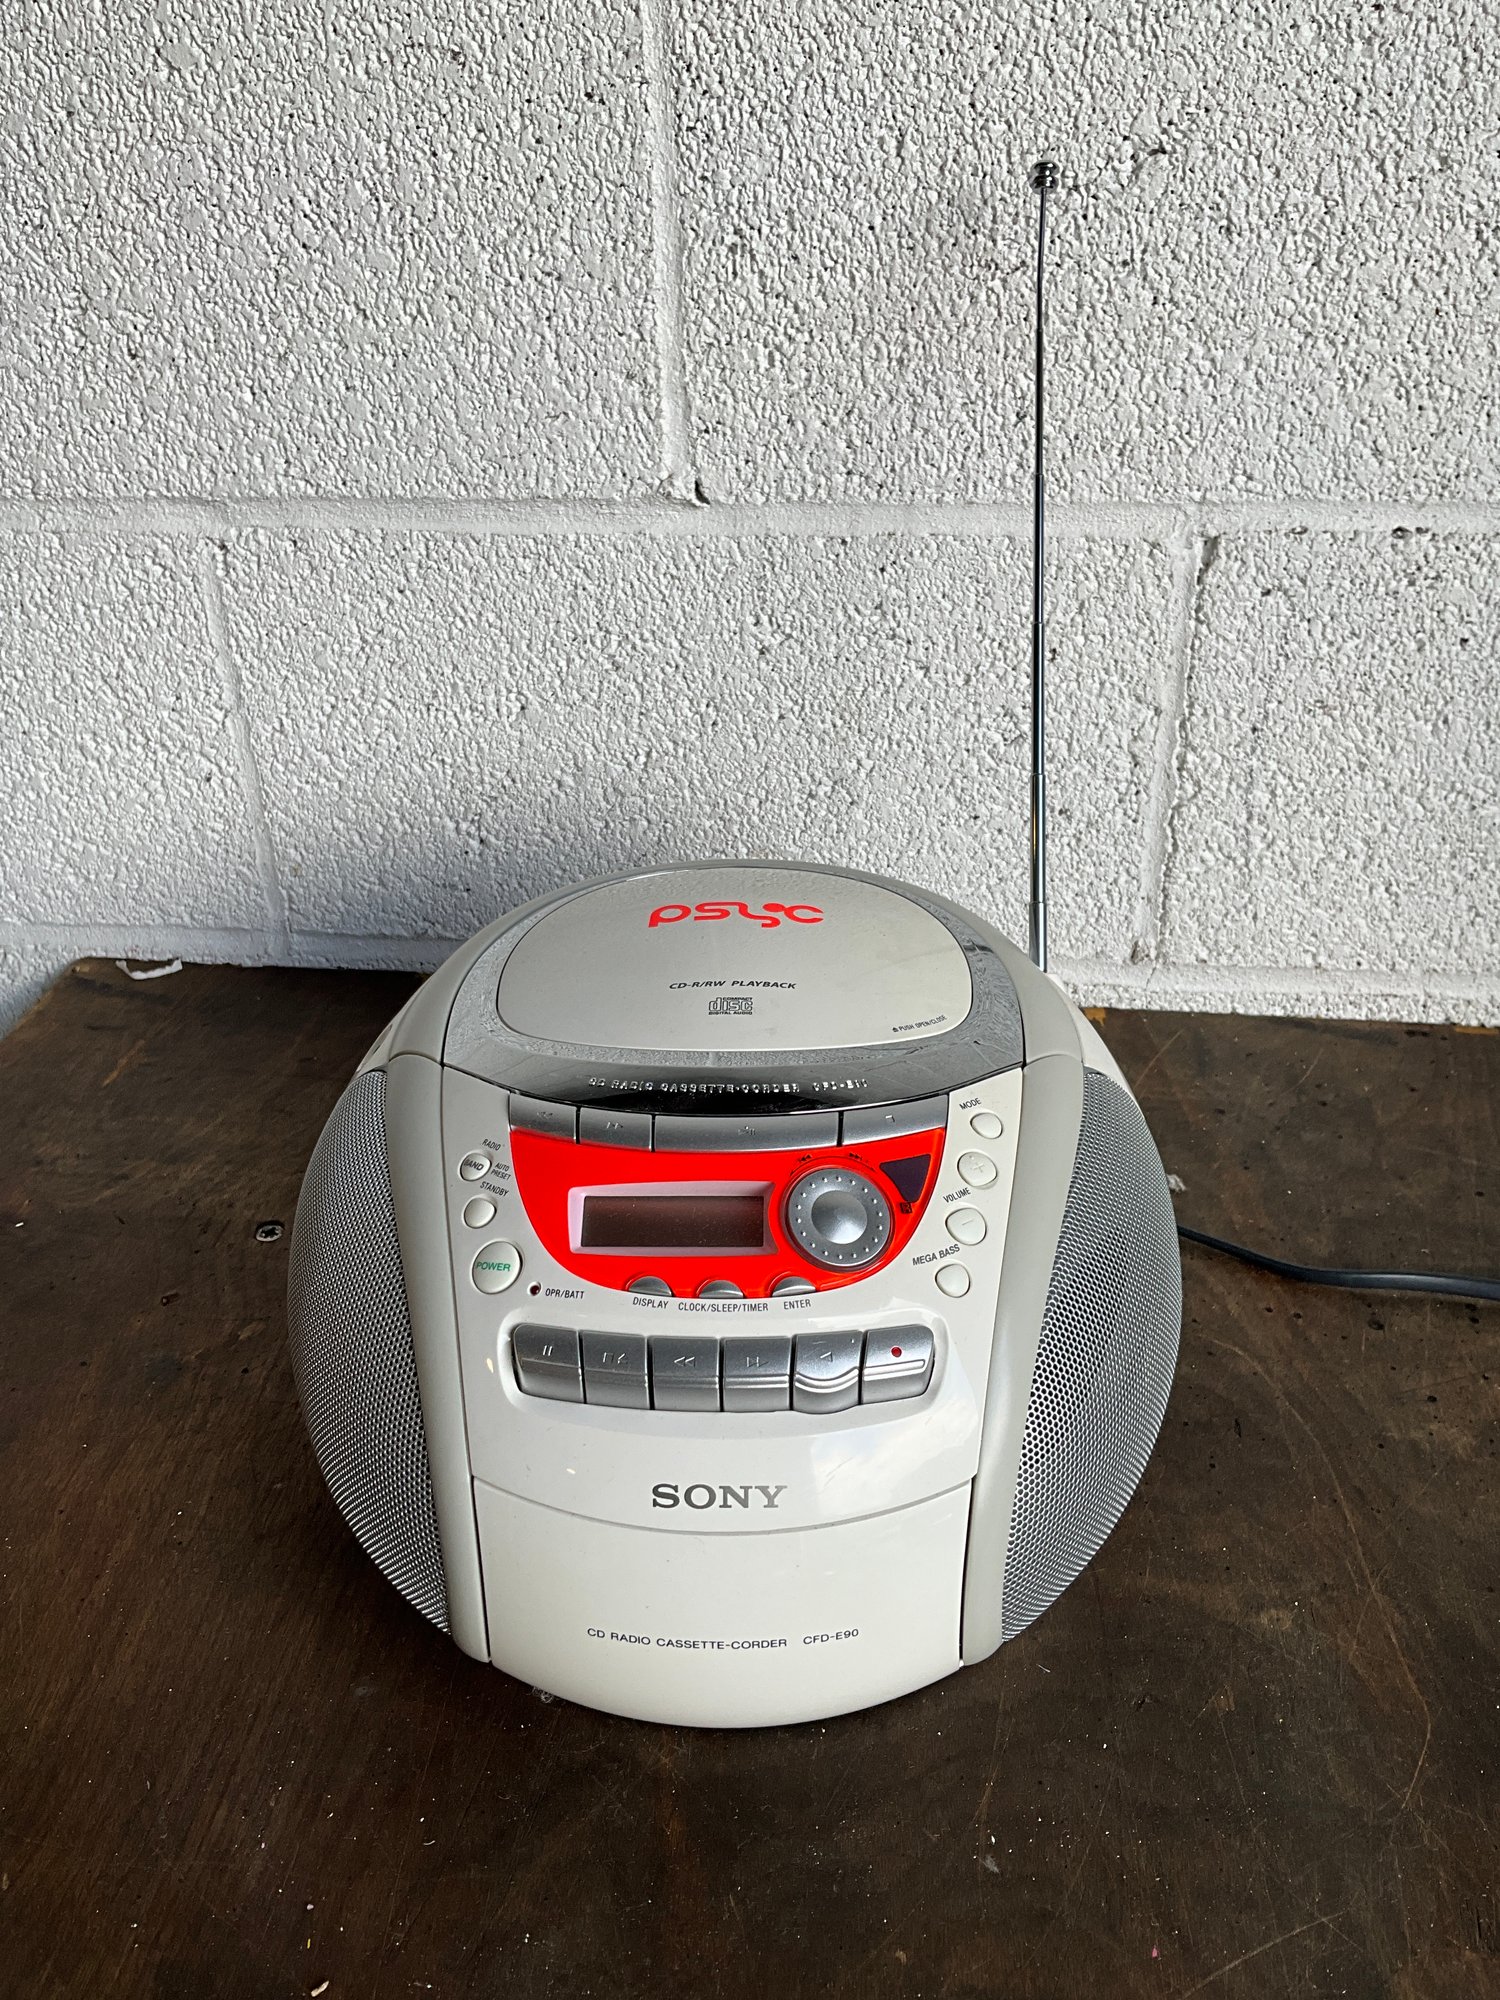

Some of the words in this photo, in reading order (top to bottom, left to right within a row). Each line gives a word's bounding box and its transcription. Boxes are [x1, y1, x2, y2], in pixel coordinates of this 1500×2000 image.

[669, 980, 726, 990] CD-R/RW
[731, 980, 797, 990] PLAYBACK
[708, 997, 754, 1012] disc
[898, 1024, 915, 1032] PUSH
[914, 1014, 947, 1029] OPEN/CLOSE
[959, 1097, 982, 1110] MODE
[481, 1138, 502, 1151] RADIO
[494, 1162, 510, 1172] AUTO
[490, 1169, 511, 1181] PRESET
[479, 1180, 509, 1197] STANDBY
[942, 1187, 972, 1203] VOLUME
[911, 1252, 938, 1266] MEGA
[938, 1243, 961, 1259] BASS
[476, 1262, 511, 1272] POWER
[545, 1287, 585, 1300] OPR/BATT
[632, 1296, 669, 1309] DISPLAY
[678, 1302, 769, 1312] CLOCK/SLEEP/TIMER
[783, 1298, 812, 1310] ENTER
[652, 1483, 787, 1509] SONY
[587, 1628, 606, 1639] CD
[610, 1632, 651, 1646] RADIO
[655, 1637, 788, 1650] CASSETTE-CORDER
[802, 1628, 860, 1646] CFD-E90
